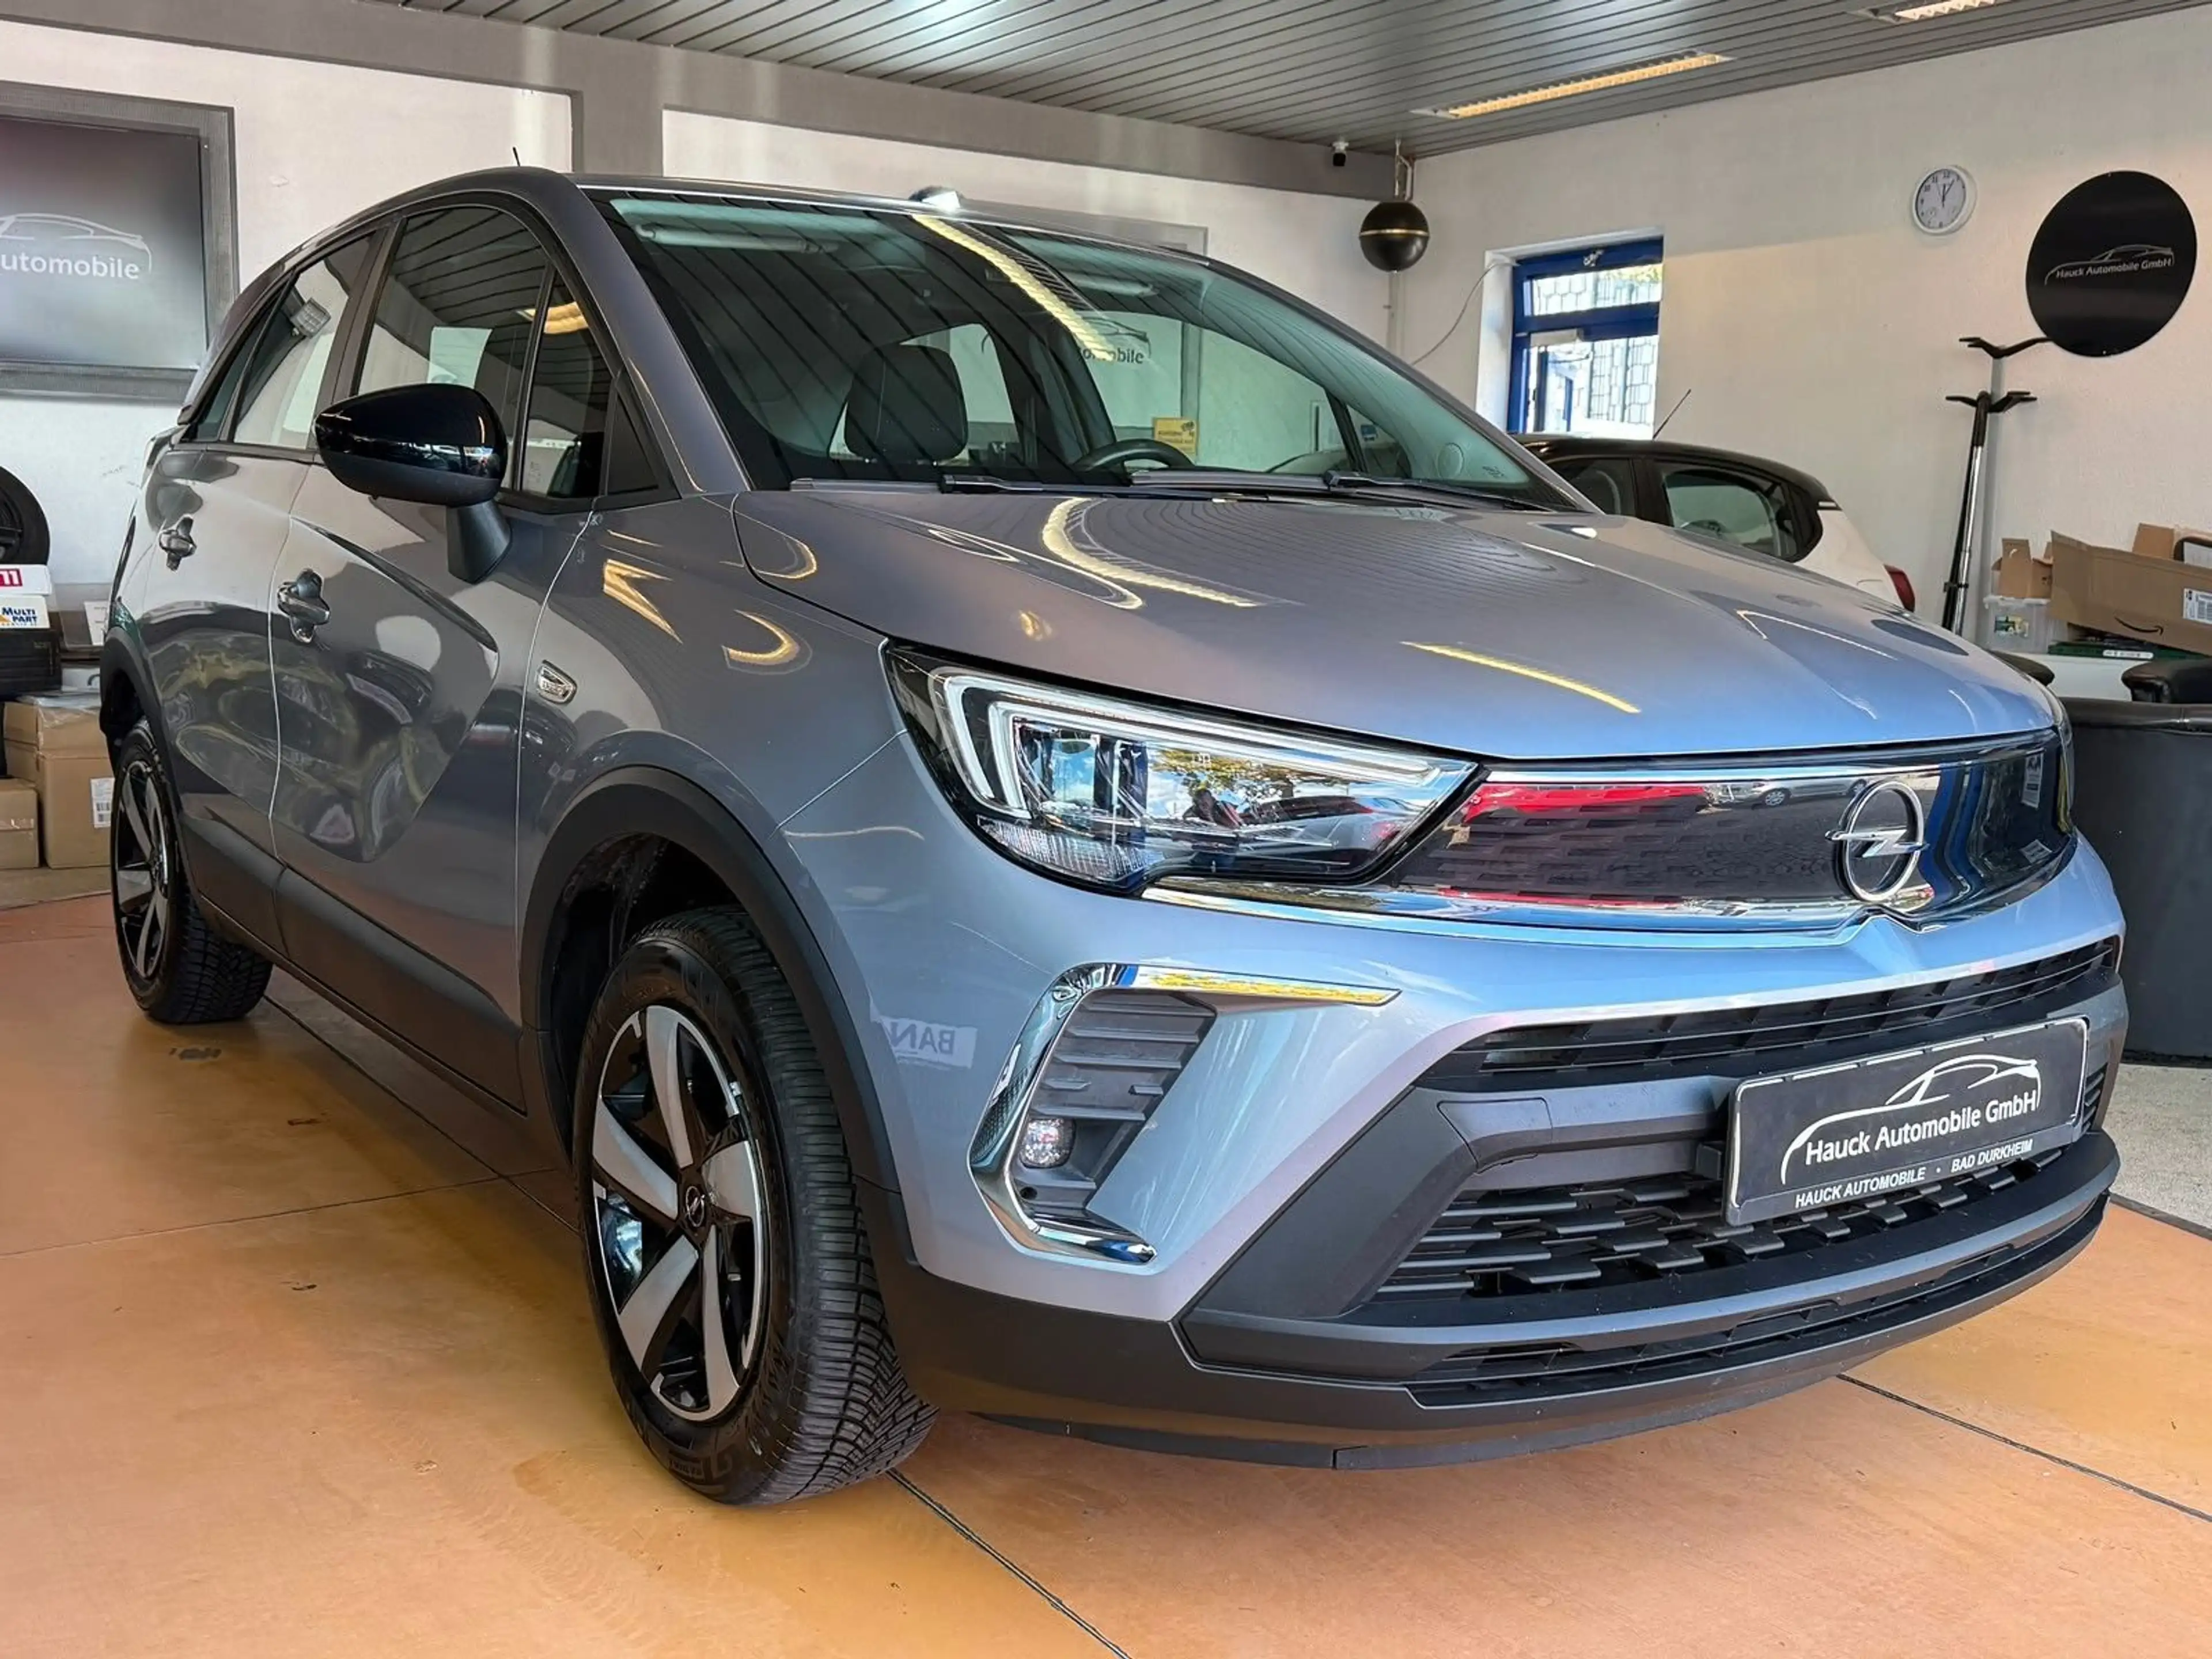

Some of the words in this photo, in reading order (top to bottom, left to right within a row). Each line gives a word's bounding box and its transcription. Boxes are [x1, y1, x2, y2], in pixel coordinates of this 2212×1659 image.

[2055, 267, 2085, 279] Hauck
[2086, 260, 2139, 276] Automobile
[2141, 258, 2172, 270] GmbH
[1805, 1131, 1870, 1166] Hauck
[1874, 1105, 1982, 1151] Automobile
[1985, 1089, 2037, 1124] GmbH
[1795, 1185, 1843, 1209] HAUCK
[1843, 1166, 1927, 1198] AUTOMOBILE
[1951, 1154, 1976, 1173] BAD
